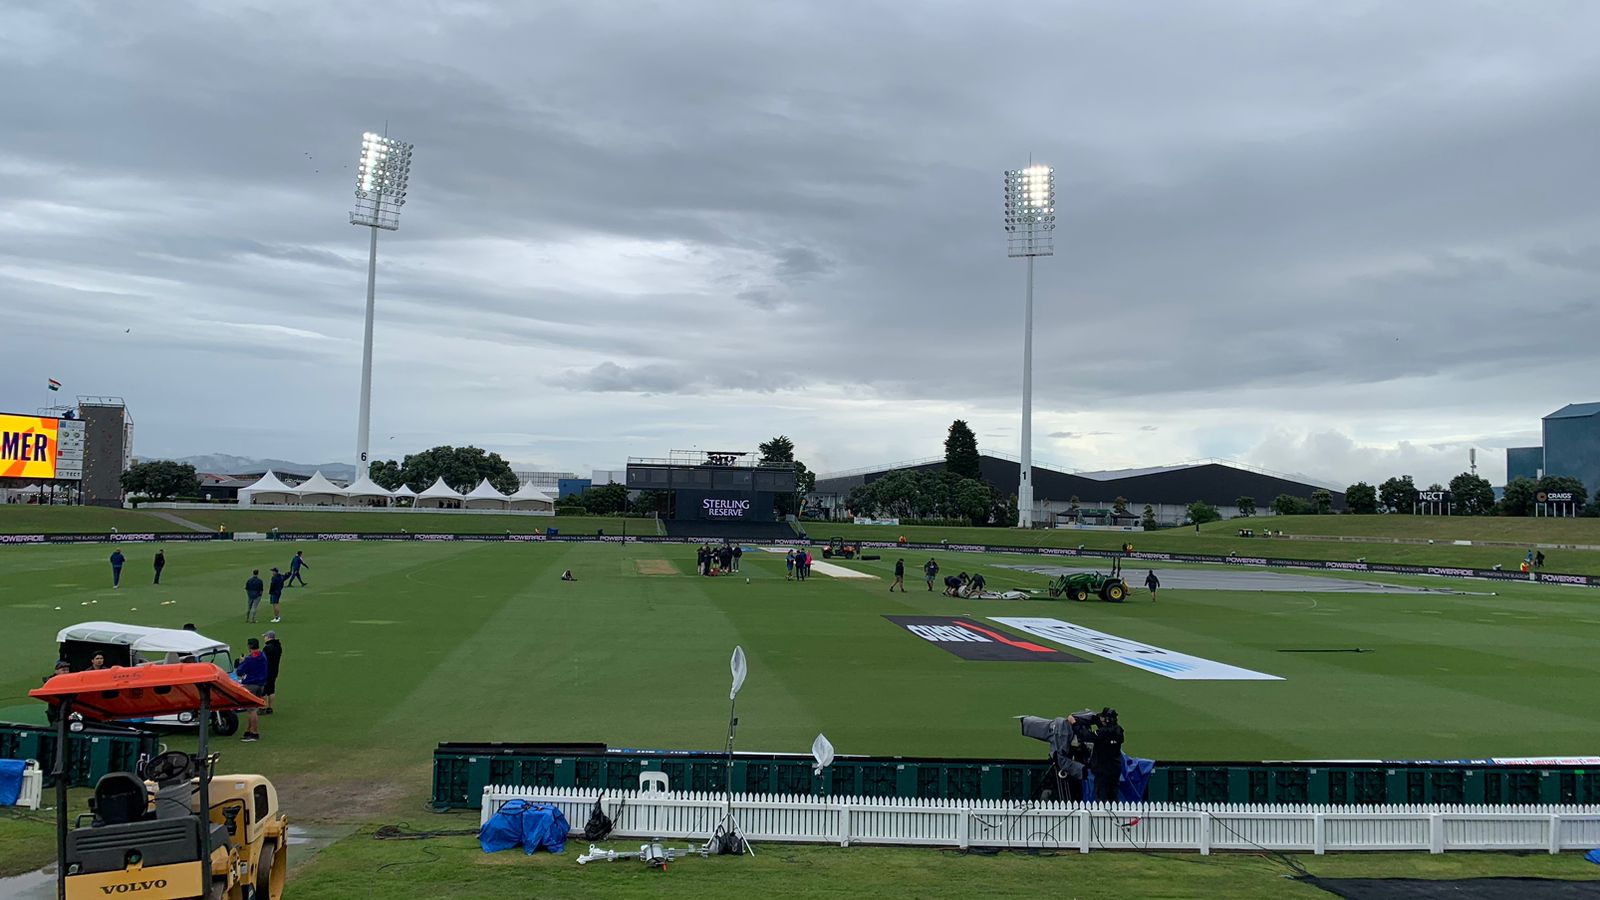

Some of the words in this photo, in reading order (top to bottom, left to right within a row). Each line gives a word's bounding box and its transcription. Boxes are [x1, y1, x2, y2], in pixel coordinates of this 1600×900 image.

[2, 432, 47, 461] MER
[361, 452, 366, 461] 6
[1022, 471, 1026, 480] 1
[1420, 492, 1444, 500] NZCT
[703, 499, 750, 509] STERLING
[1326, 562, 1368, 570] POWERADE
[1428, 568, 1474, 576] POWERADE
[1542, 575, 1586, 584] POWERADE
[100, 880, 167, 894] VOLVO
